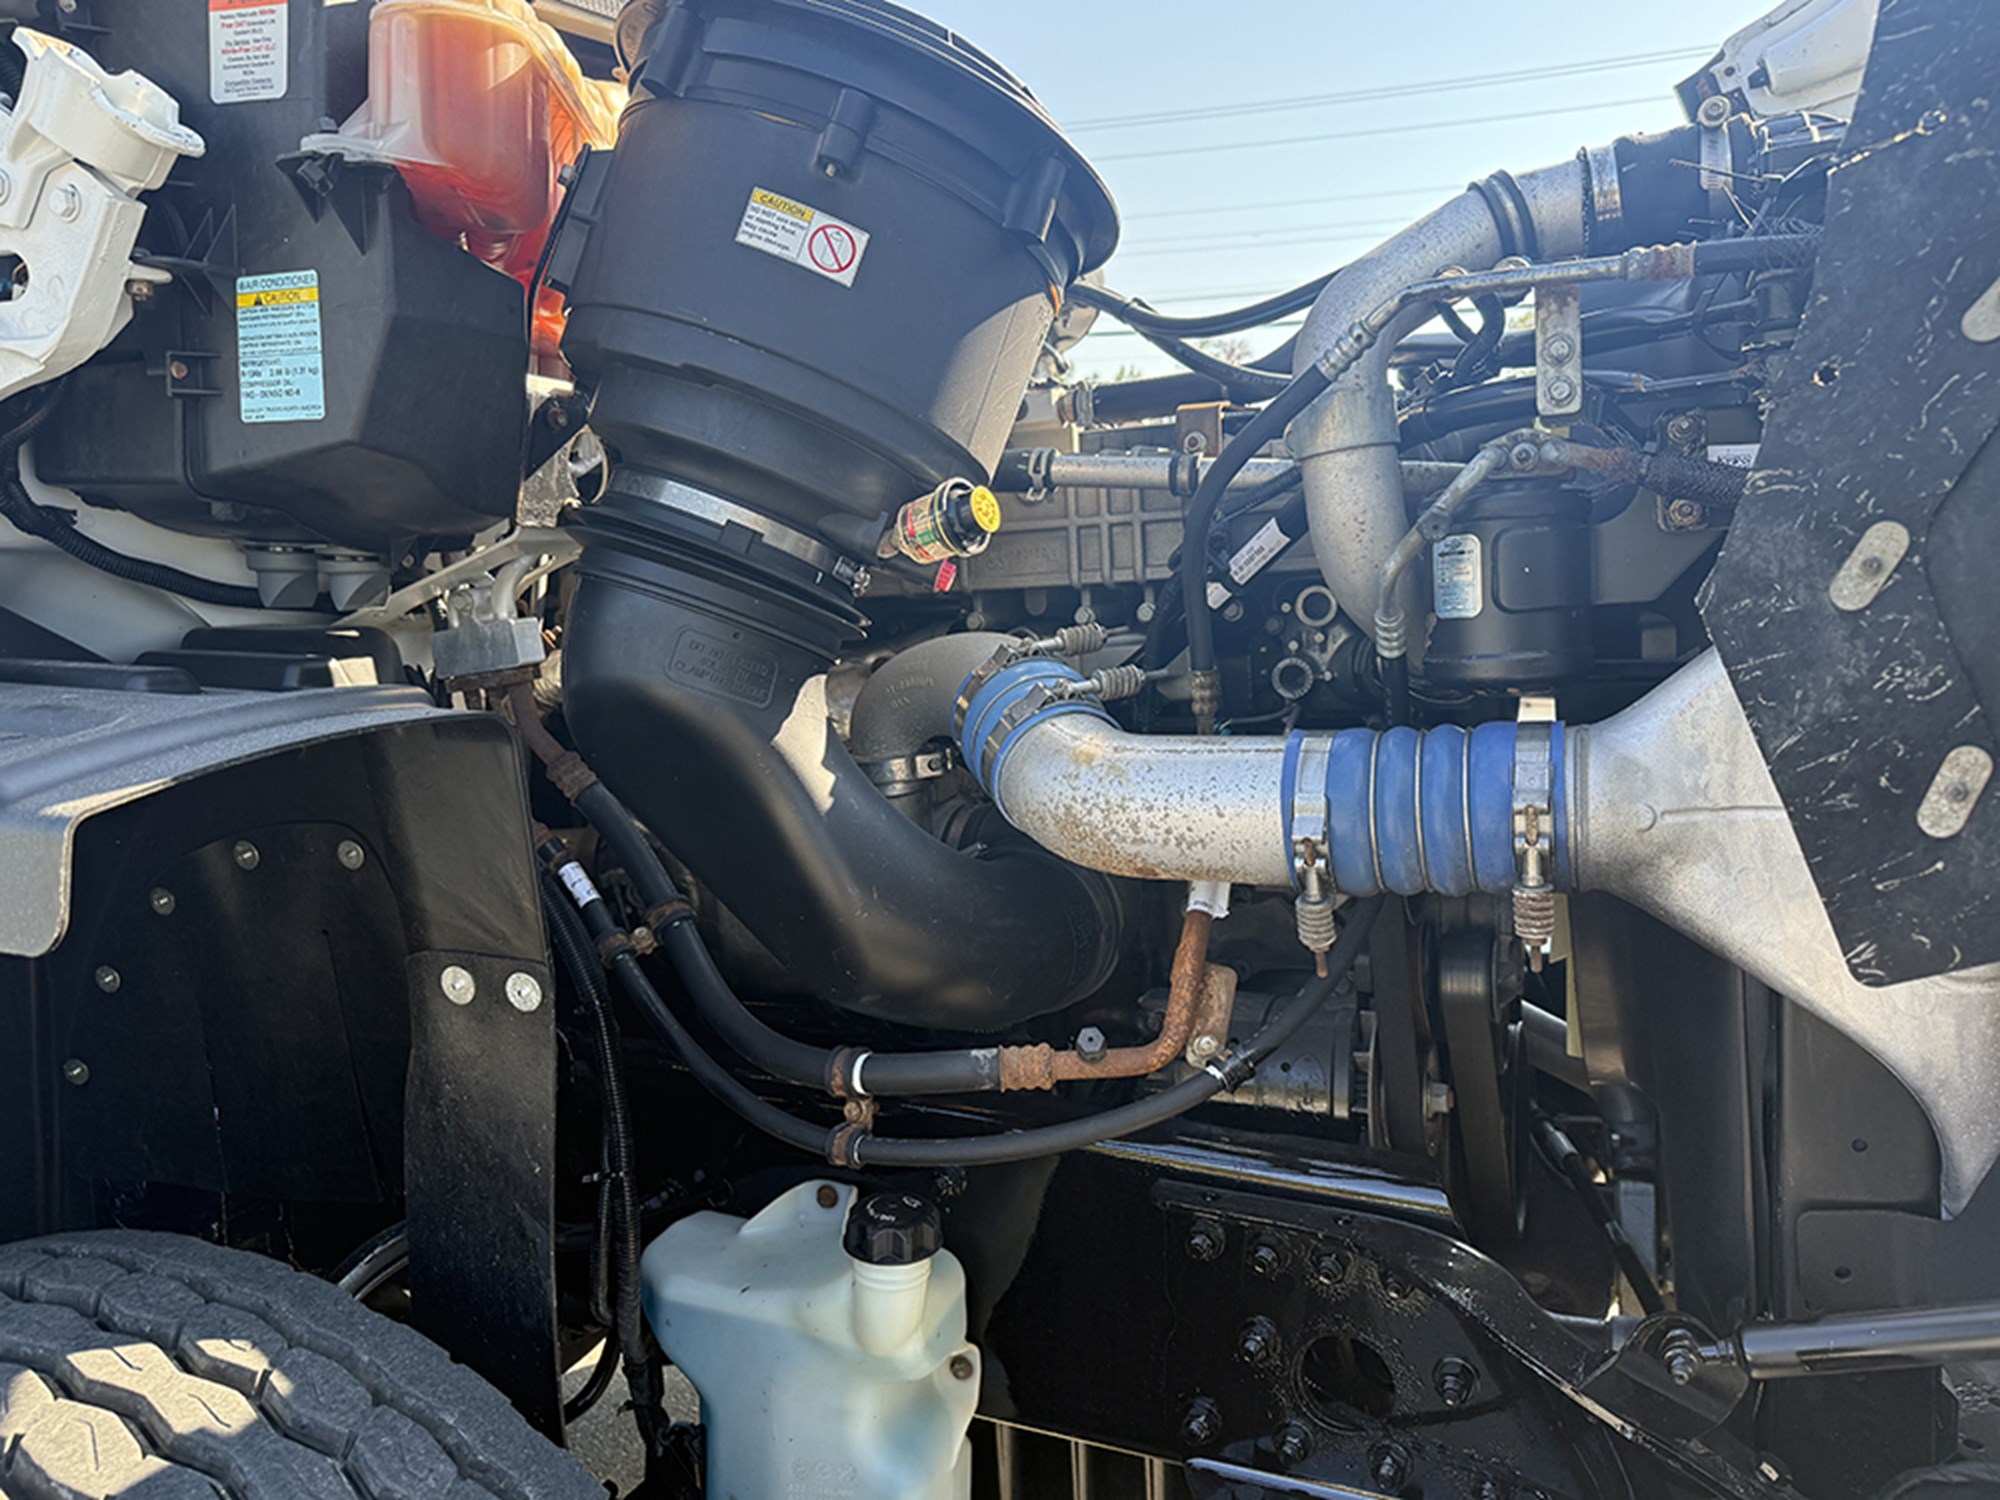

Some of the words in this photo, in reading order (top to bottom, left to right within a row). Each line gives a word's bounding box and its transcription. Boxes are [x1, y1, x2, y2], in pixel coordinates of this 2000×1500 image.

[760, 194, 806, 216] CAUTION
[762, 210, 777, 219] NOT
[756, 217, 779, 230] starting
[740, 230, 762, 238] engine
[758, 227, 777, 237] cause
[246, 280, 258, 289] AIR
[260, 274, 314, 288] CONDITIONER
[265, 291, 301, 304] CAUTION
[689, 640, 705, 652] DO
[708, 647, 728, 660] NOT
